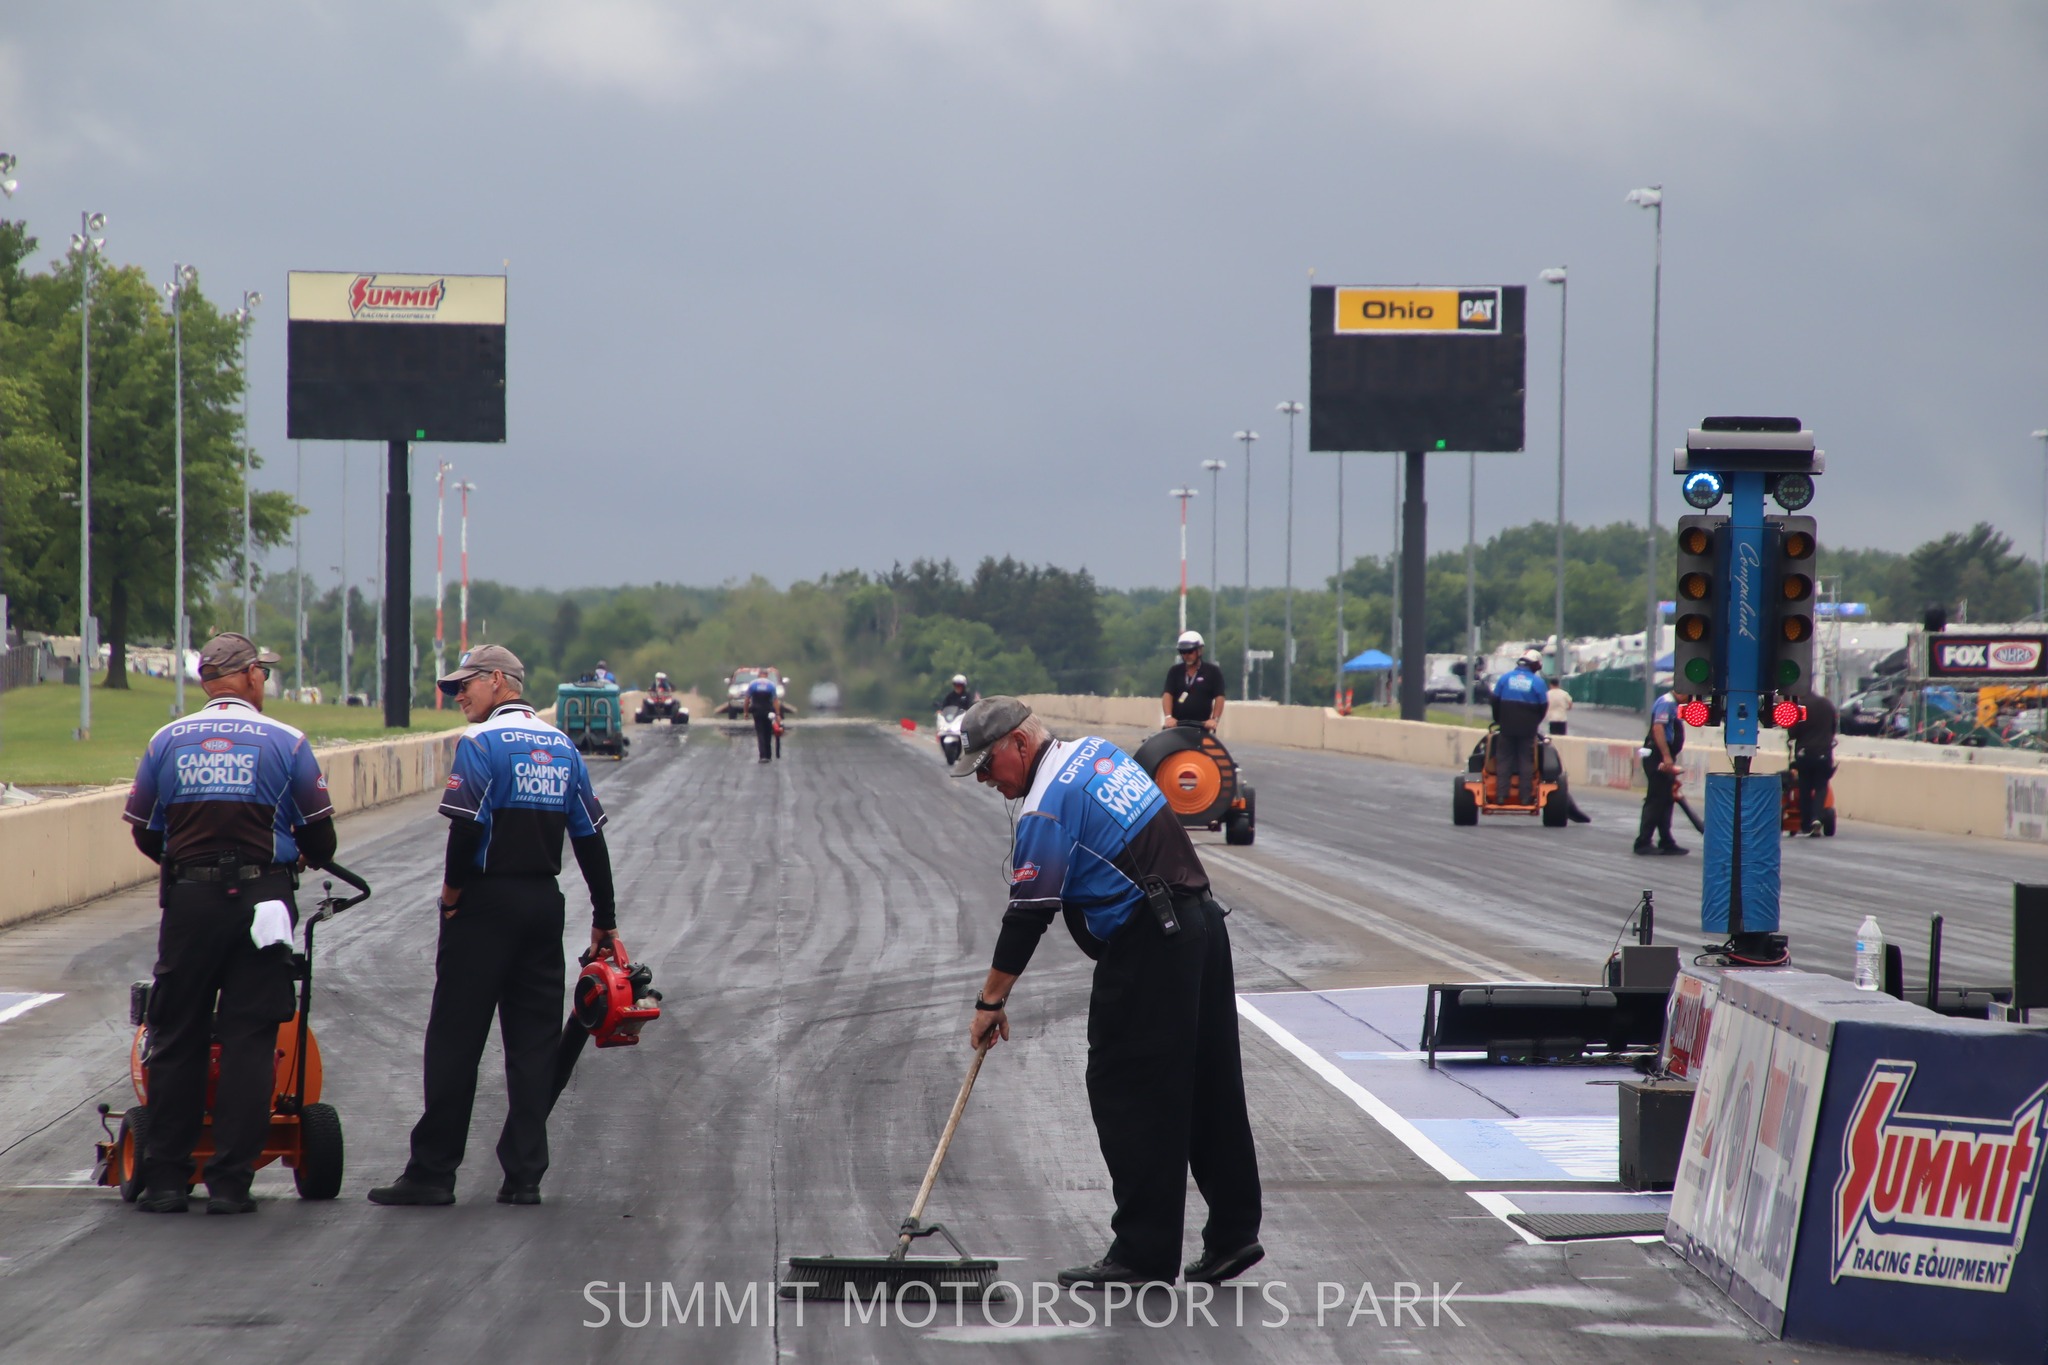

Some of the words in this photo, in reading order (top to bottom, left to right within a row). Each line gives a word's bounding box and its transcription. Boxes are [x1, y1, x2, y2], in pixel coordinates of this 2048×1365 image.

[1362, 301, 1434, 319] Ohio
[1461, 299, 1494, 321] CAT
[1944, 645, 1987, 667] FOX
[1997, 648, 2032, 661] NHRA
[171, 722, 268, 737] OFFICIAL
[500, 731, 572, 749] OFFICIAL
[177, 753, 254, 769] CAMPING
[514, 762, 569, 781] CAMPING
[178, 767, 253, 786] WORLD
[516, 776, 568, 797] WORLD
[1096, 757, 1139, 804] CAMPING
[1107, 770, 1153, 816] WORLD
[1852, 1247, 1910, 1274] RACING
[1913, 1254, 2009, 1286] EQUIPMENT
